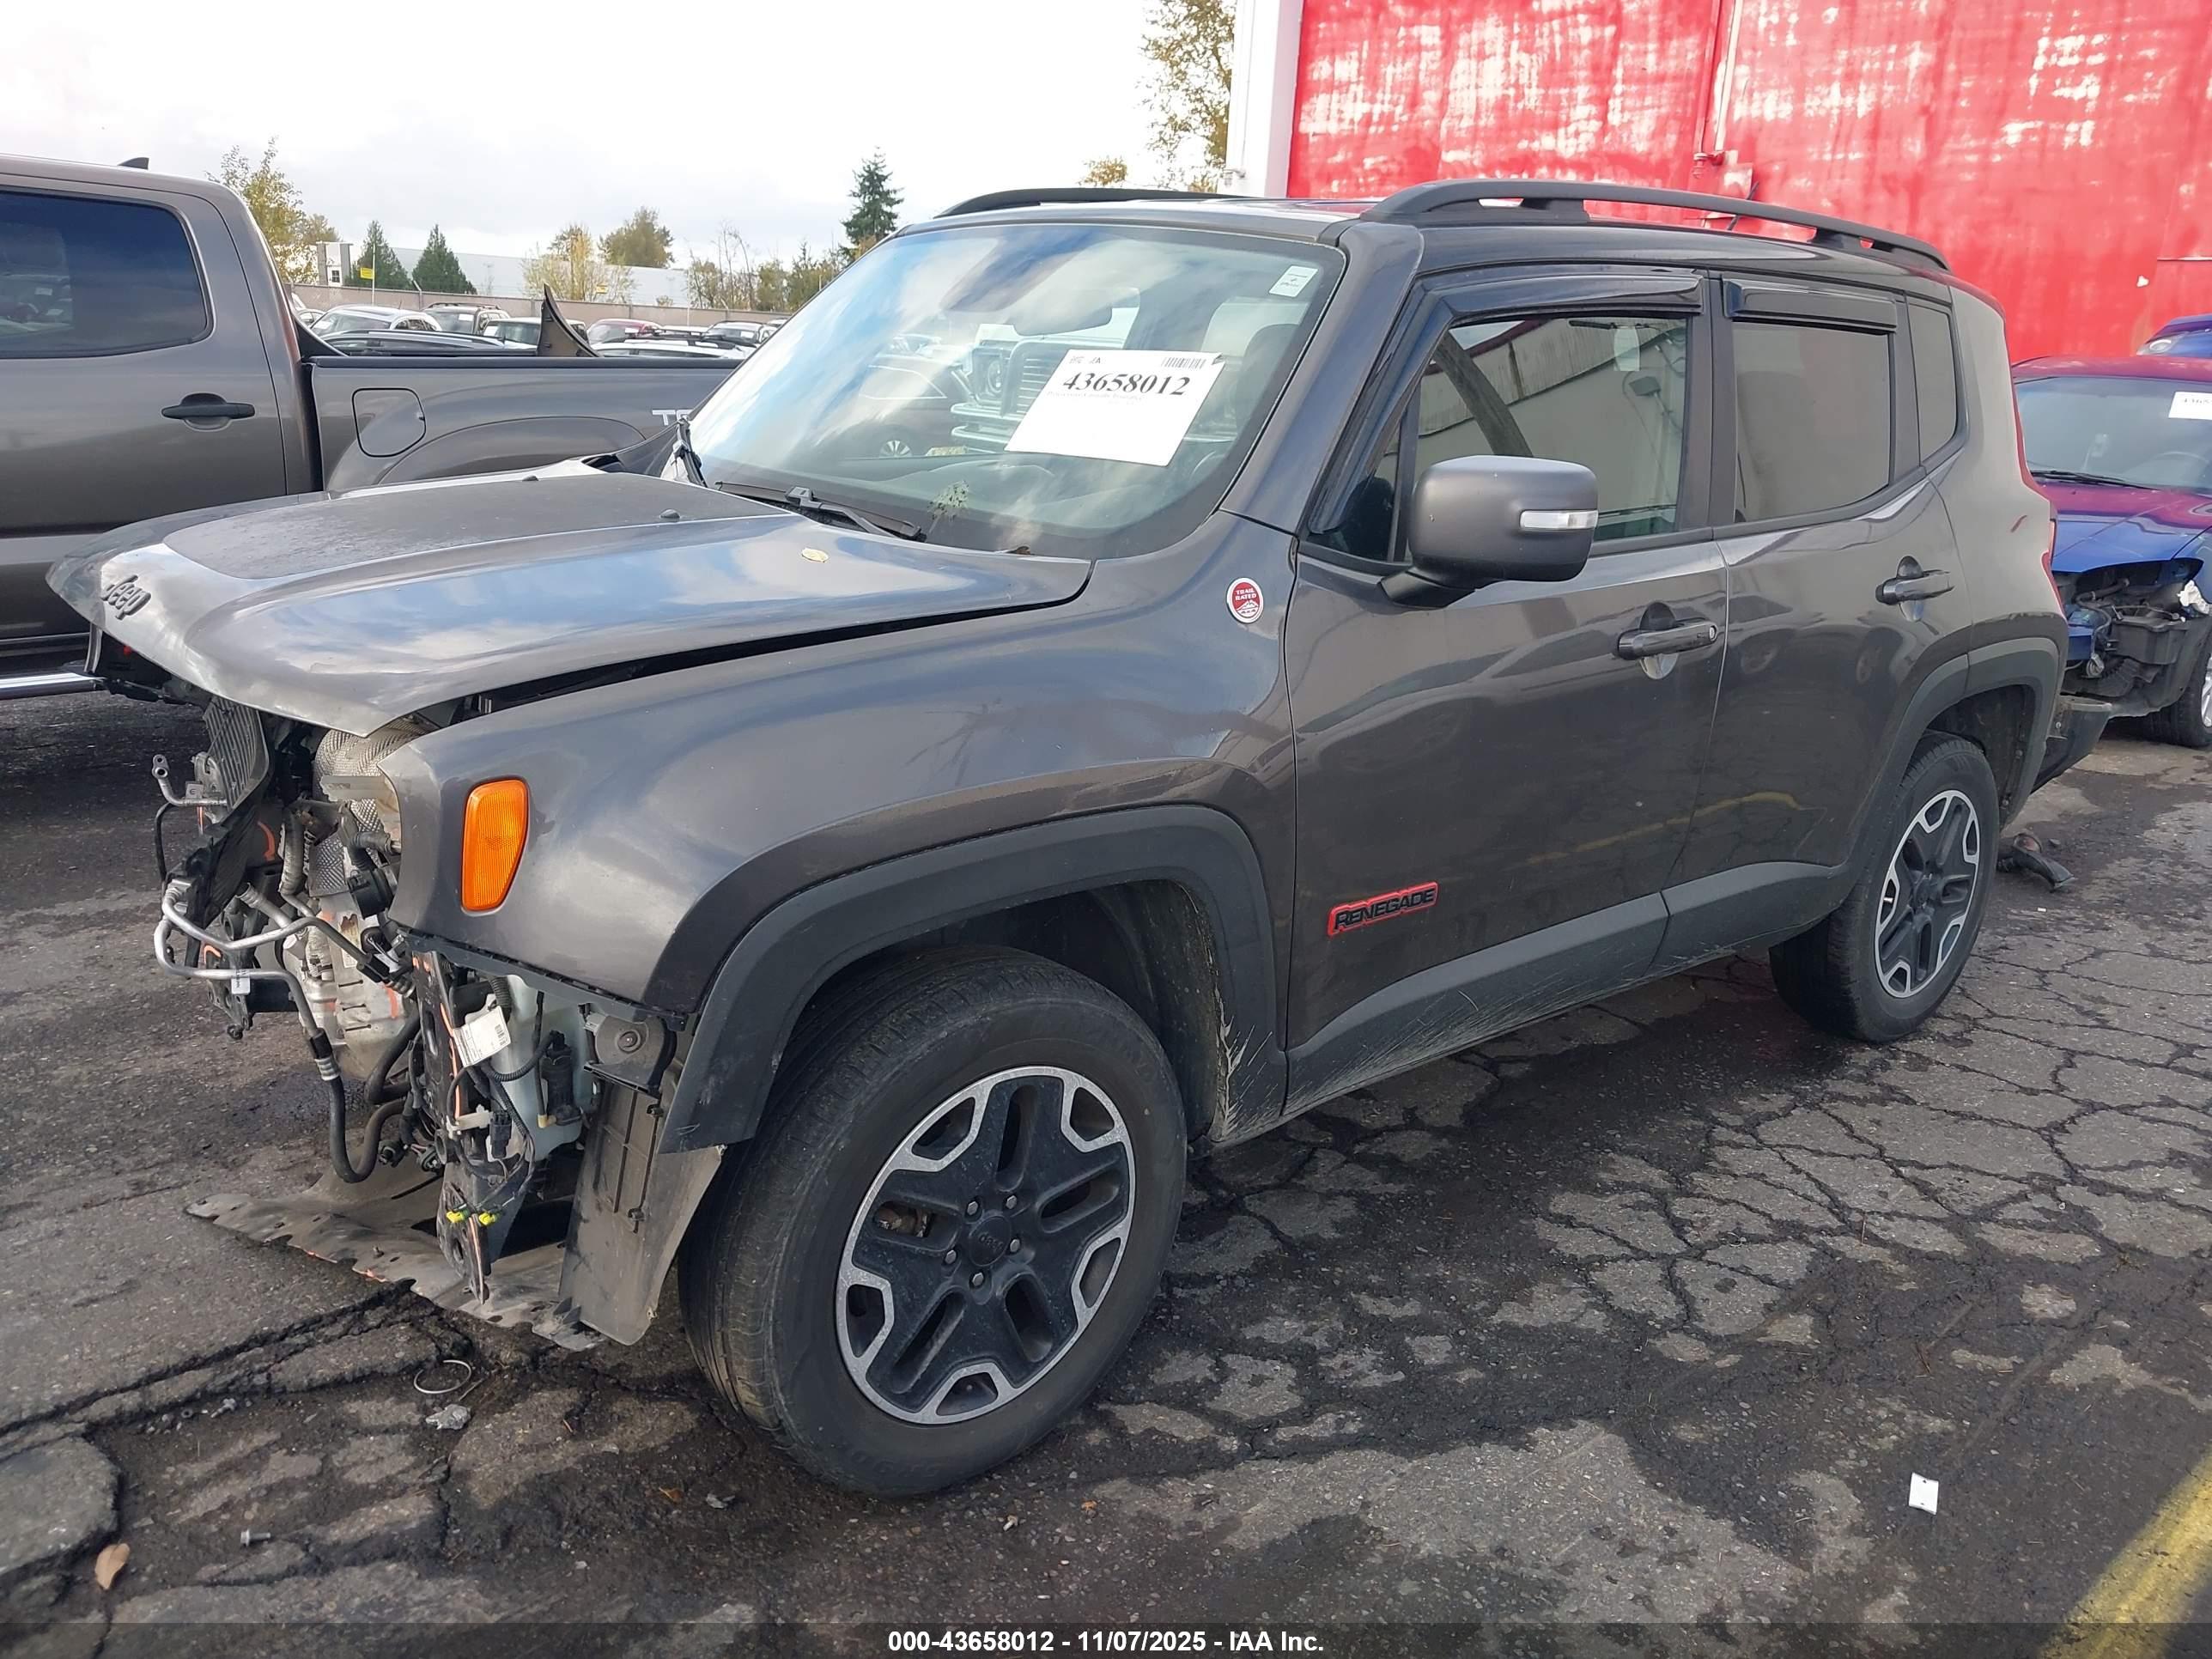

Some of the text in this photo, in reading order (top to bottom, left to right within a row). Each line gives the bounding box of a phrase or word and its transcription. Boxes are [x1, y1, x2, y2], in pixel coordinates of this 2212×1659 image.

[1062, 372, 1191, 396] 43658012
[100, 574, 151, 621] Jeep
[1334, 886, 1437, 930] RENEGADE
